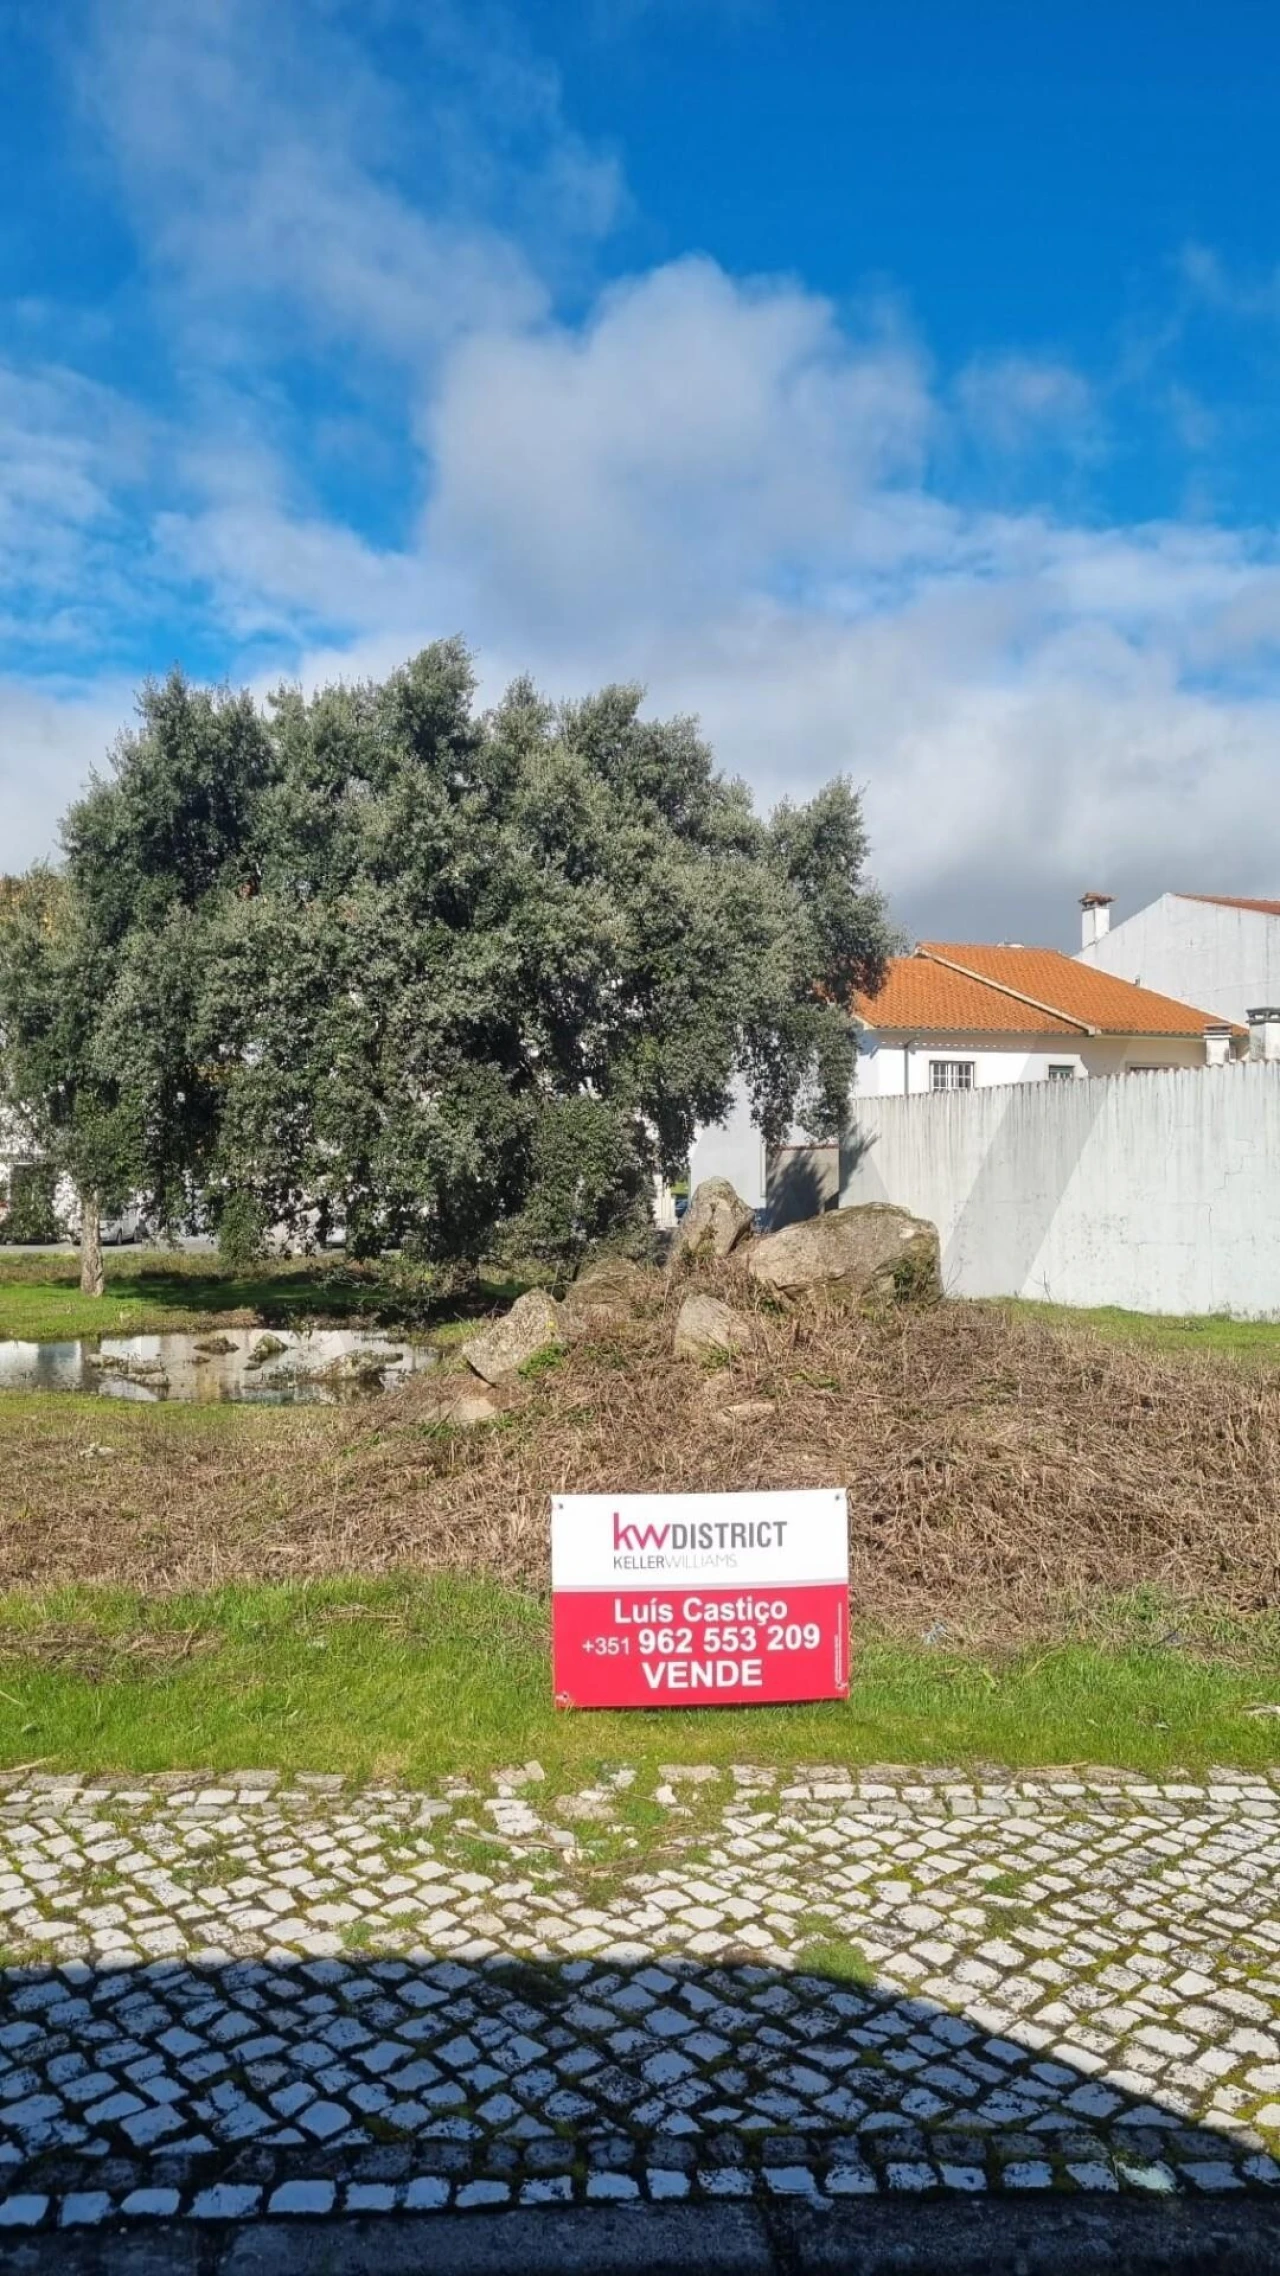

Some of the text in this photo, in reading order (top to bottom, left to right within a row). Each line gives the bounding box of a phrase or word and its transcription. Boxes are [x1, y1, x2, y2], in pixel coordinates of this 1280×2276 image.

[614, 1596, 788, 1626] Luís Castiço
[582, 1623, 821, 1656] +351 962 553 209
[641, 1659, 763, 1689] VENDE
